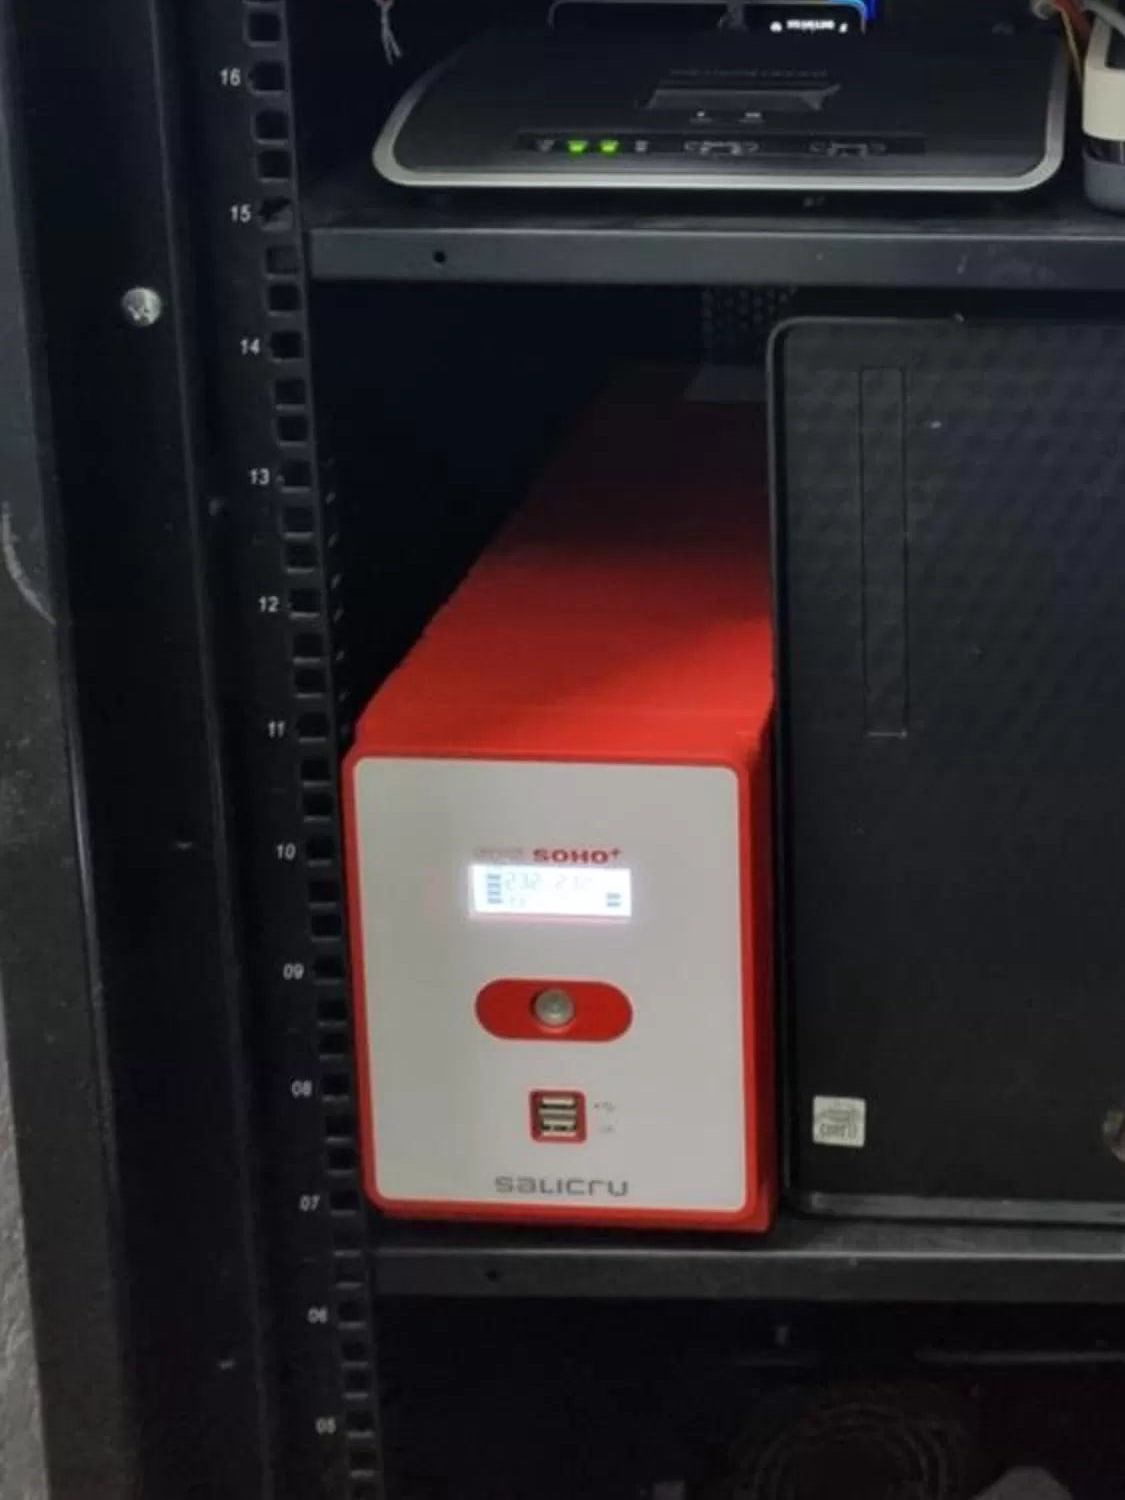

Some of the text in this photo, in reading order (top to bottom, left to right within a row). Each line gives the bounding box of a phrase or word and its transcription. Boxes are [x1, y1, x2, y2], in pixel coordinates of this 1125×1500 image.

[221, 68, 240, 86] 16
[232, 205, 250, 222] 15
[241, 339, 259, 354] 14
[251, 468, 269, 485] 13
[259, 596, 278, 612] 12
[268, 721, 285, 736] 11
[277, 844, 296, 860] 10
